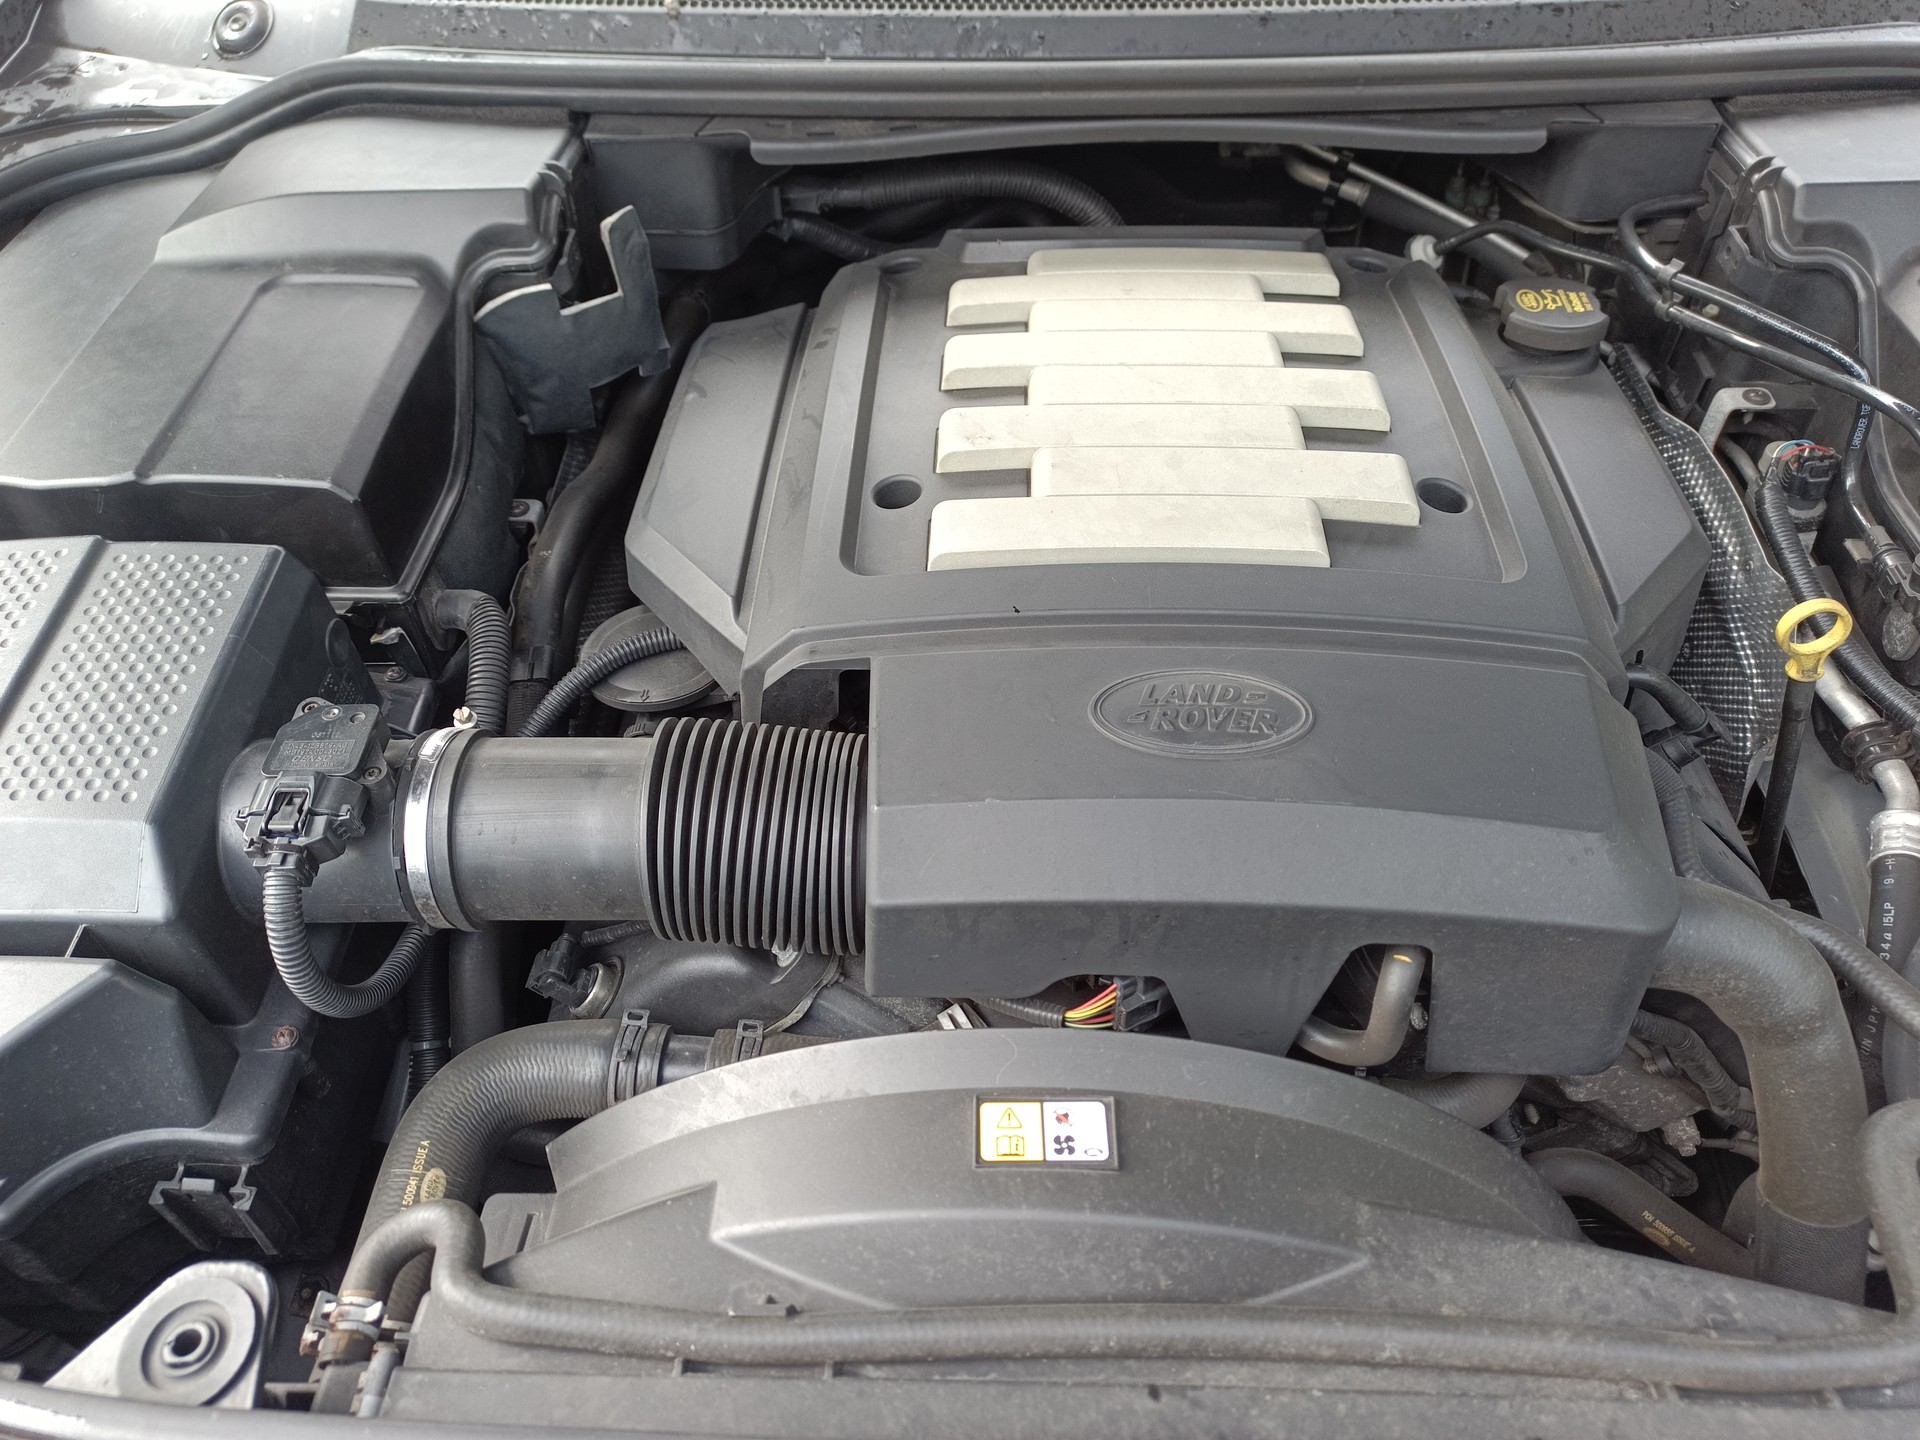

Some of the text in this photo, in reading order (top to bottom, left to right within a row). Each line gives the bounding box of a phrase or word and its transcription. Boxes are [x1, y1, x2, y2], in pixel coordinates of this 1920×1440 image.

[1139, 683, 1242, 706] LAND
[1150, 706, 1279, 734] ROVER
[402, 1176, 420, 1206] 500941
[411, 1147, 429, 1173] ISSUE
